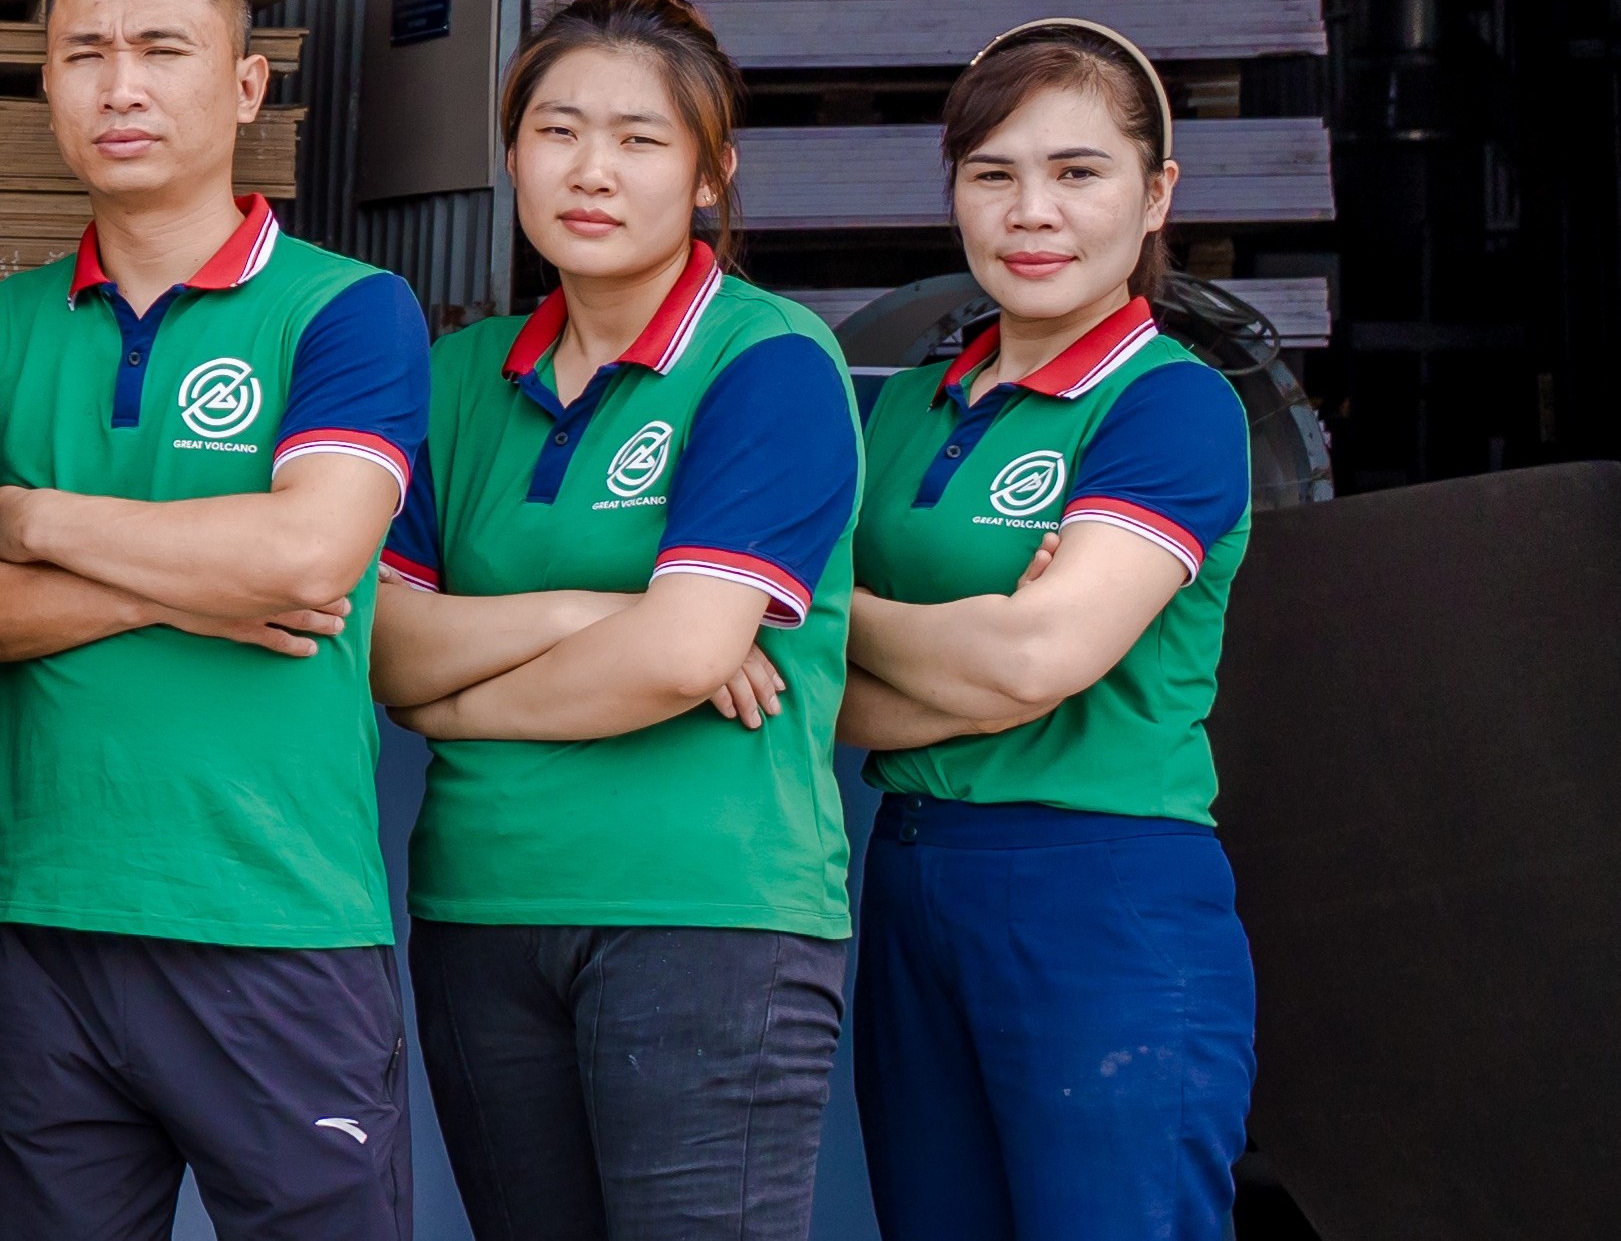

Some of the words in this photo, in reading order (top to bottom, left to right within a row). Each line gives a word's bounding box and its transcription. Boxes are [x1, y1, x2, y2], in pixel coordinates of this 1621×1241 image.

[173, 440, 203, 449] GREAT
[205, 441, 258, 453] VOLCANO
[592, 501, 620, 510] GREAT
[621, 496, 667, 508] VOLCANO
[972, 516, 1004, 525] GREAT
[1005, 518, 1060, 530] VOLCANO
